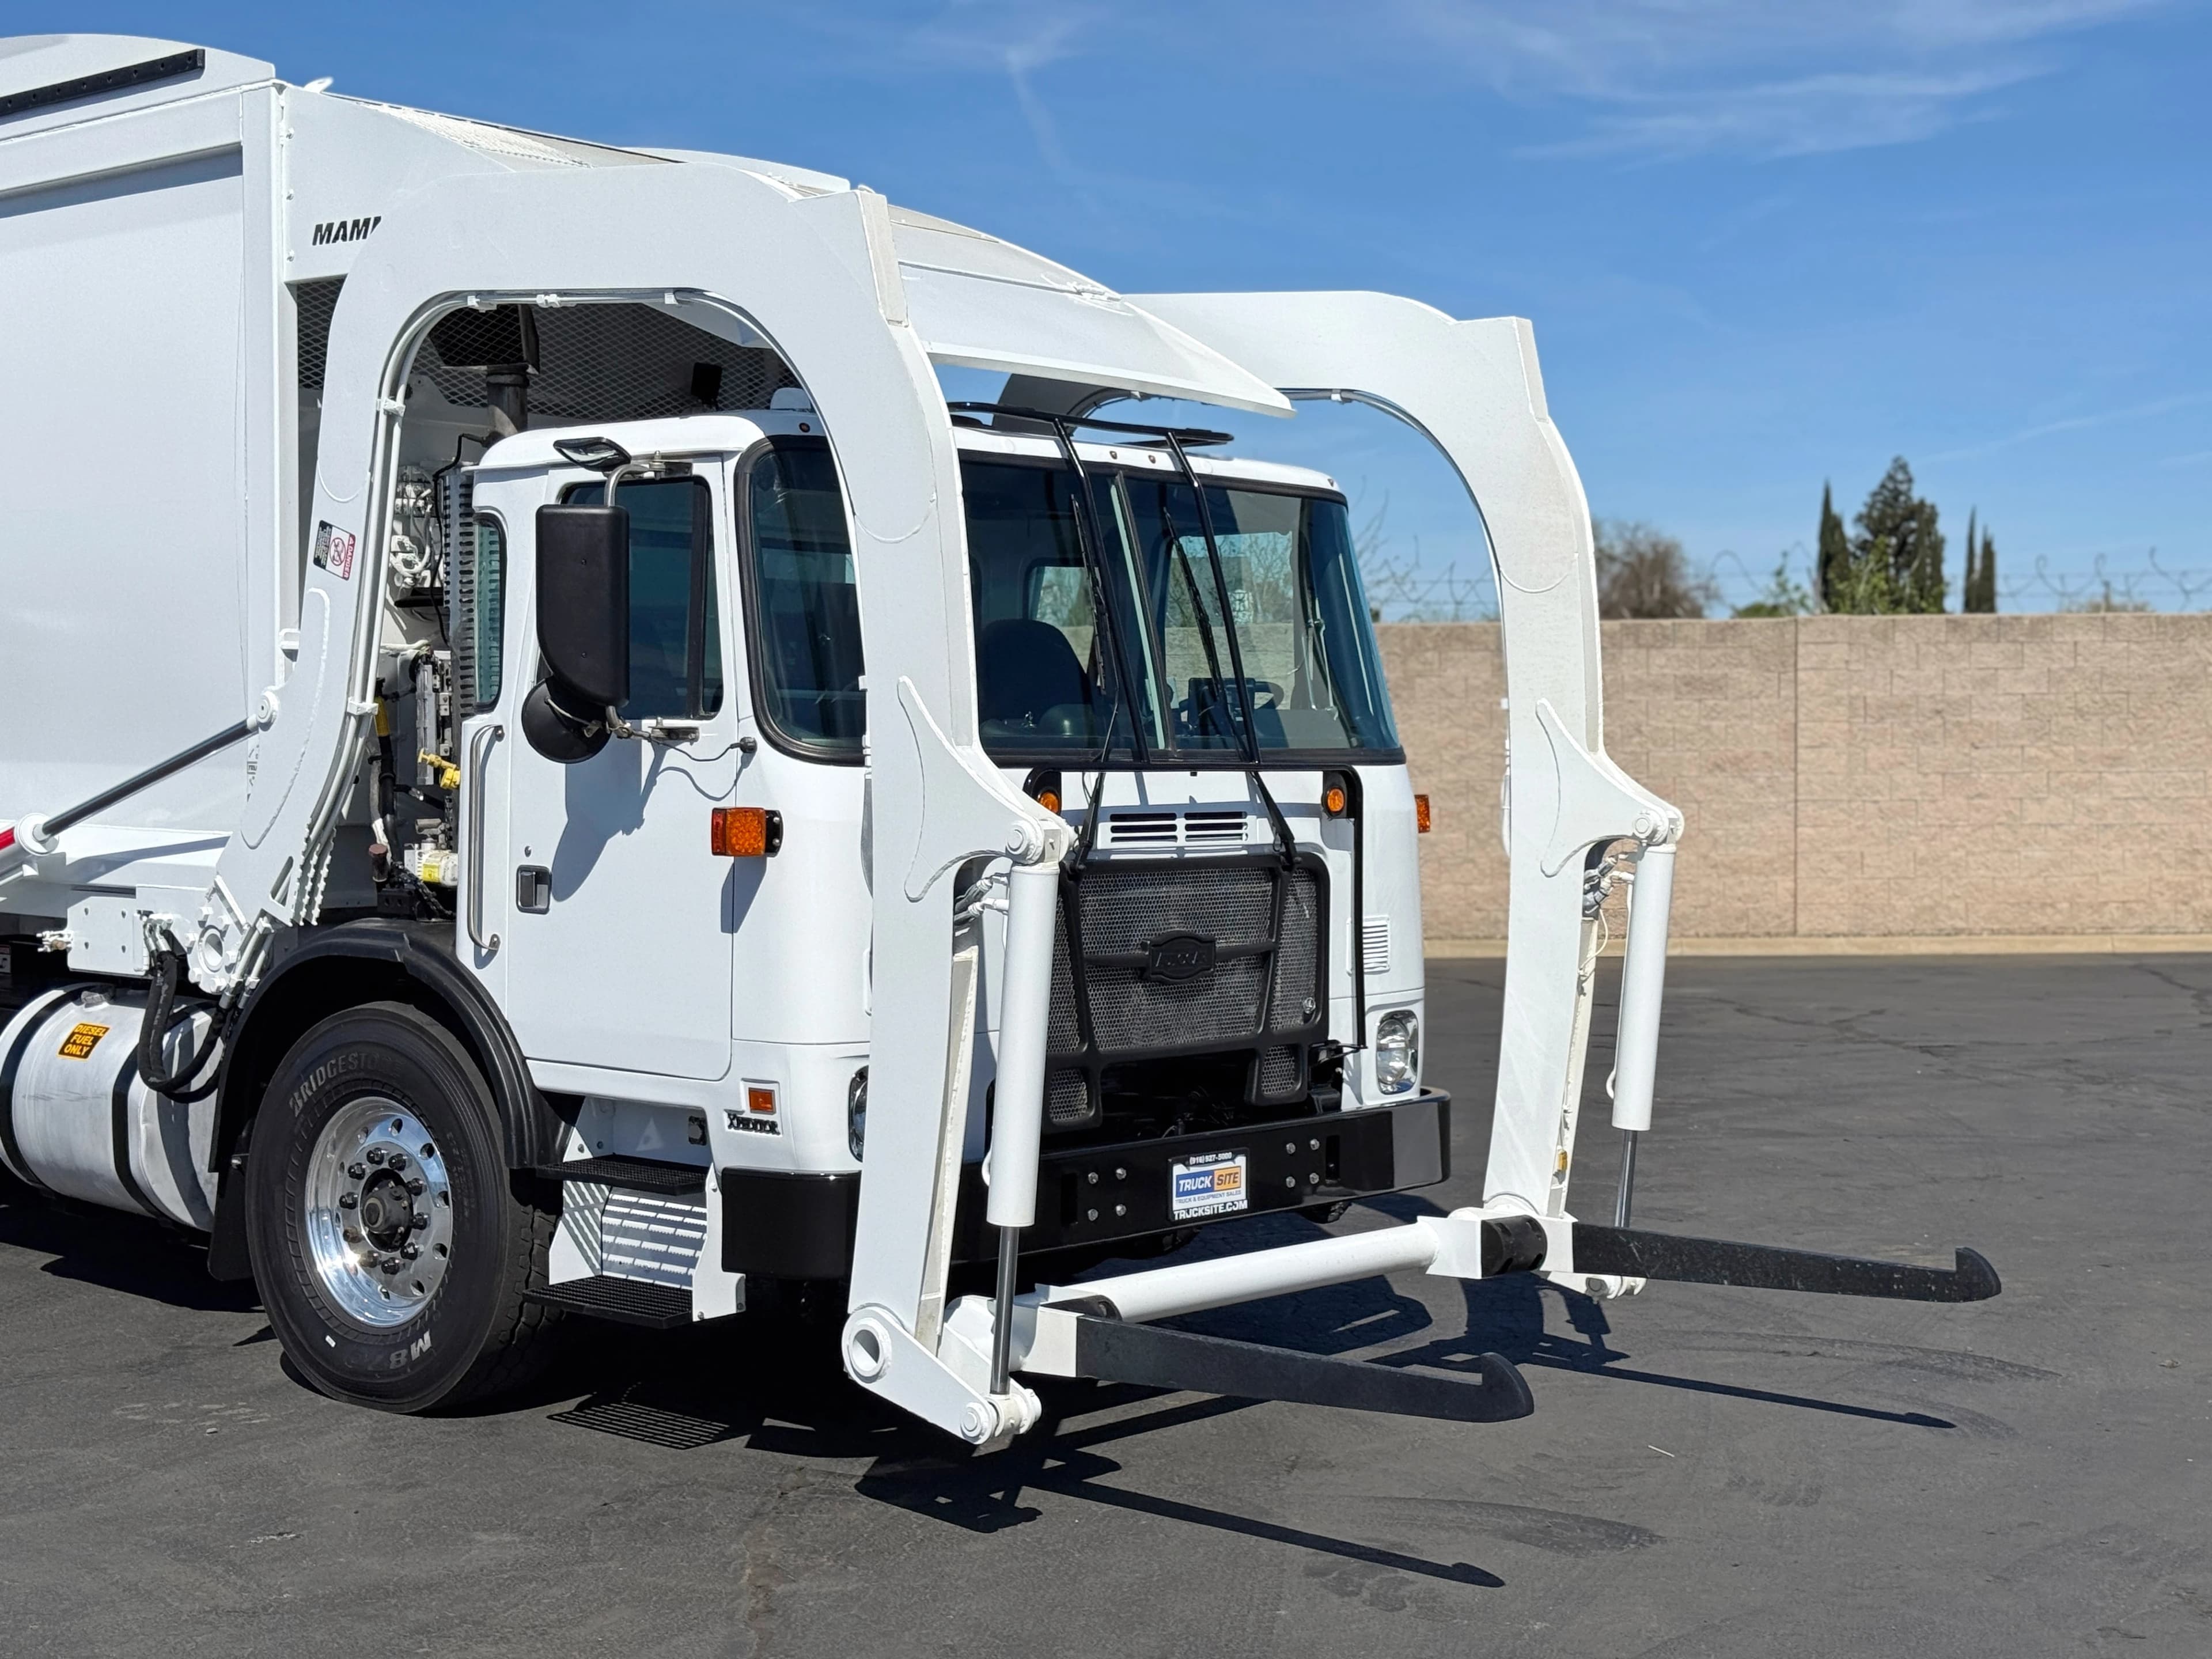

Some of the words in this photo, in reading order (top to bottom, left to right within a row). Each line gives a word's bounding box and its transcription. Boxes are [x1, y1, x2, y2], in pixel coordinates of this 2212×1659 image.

[74, 1025, 106, 1036] DIESEL
[70, 1035, 93, 1046] FUEL
[64, 1044, 90, 1055] ONLY
[1179, 1176, 1212, 1192] TRUCK
[1217, 1172, 1238, 1185] SITE
[1198, 1192, 1225, 1200] EQUIPMENT
[1174, 1200, 1248, 1220] TRUCKSITE.COM
